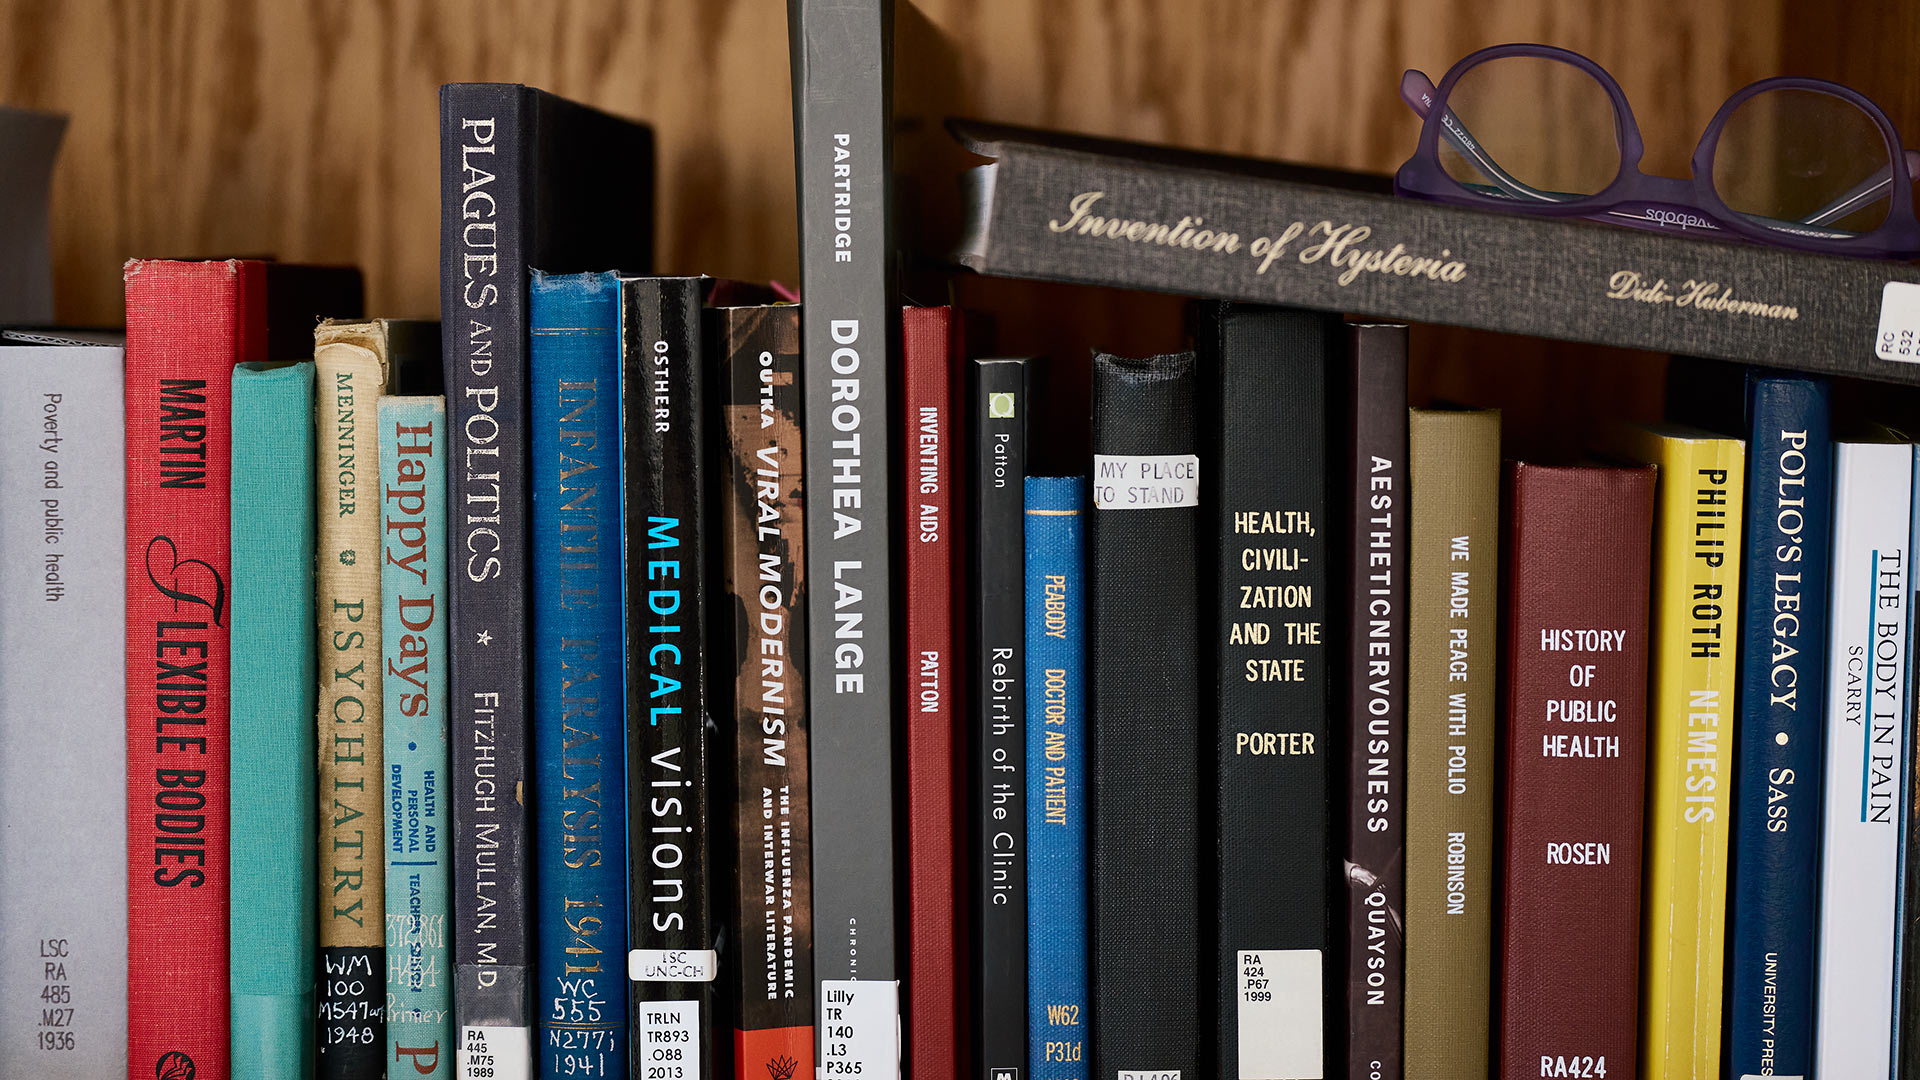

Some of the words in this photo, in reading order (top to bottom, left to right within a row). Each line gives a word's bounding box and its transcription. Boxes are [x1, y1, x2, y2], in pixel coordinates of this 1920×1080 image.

[462, 117, 498, 309] PLAGUES
[834, 133, 851, 262] PARTRIDGE
[1049, 191, 1240, 255] Invention
[1250, 222, 1304, 275] of
[1299, 220, 1468, 287] Hysteria
[1606, 270, 1799, 321] Didi-Huberman
[470, 319, 493, 376] AND
[1881, 332, 1895, 353] RC
[1899, 330, 1914, 356] 532
[654, 340, 670, 433] OSTHERR
[759, 351, 774, 429] OUTKA
[39, 393, 63, 453] Poverty
[160, 379, 206, 489] MARTIN
[336, 372, 356, 518] MENNINGER
[830, 319, 862, 540] DOROTHEA
[919, 406, 938, 494] INVENTING
[994, 433, 1010, 488] Patton
[1101, 462, 1127, 479] MY
[1141, 462, 1194, 480] PLACE
[44, 461, 63, 489] and
[465, 386, 500, 582] POLITICS
[559, 378, 600, 610] INFANTILE
[756, 446, 780, 542] VIRAL
[1096, 486, 1115, 502] TO
[1128, 486, 1184, 504] STAND
[40, 499, 64, 544] public
[386, 421, 433, 585] Happy
[920, 503, 938, 543] AIDS
[1234, 511, 1316, 537] HEALTH,
[1695, 469, 1727, 568] PHILIP
[1242, 548, 1309, 571] CIVILI-
[1451, 535, 1469, 562] WE
[45, 554, 65, 602] health
[1240, 585, 1312, 609] ZATION
[1450, 572, 1469, 619] MADE
[1878, 549, 1901, 610] THE
[647, 516, 682, 725] MEDICAL
[834, 560, 864, 694] LANGE
[1045, 574, 1066, 639] PEABODY
[1690, 584, 1723, 658] ROTH
[388, 594, 435, 718] Days
[1229, 623, 1270, 646] AND
[1284, 622, 1321, 646] THE
[1367, 455, 1392, 833] AESTHETICNERVOUSNESS
[1449, 629, 1468, 683] PEACE
[1541, 629, 1626, 651] HISTORY
[1770, 572, 1802, 711] LEGACY
[759, 553, 786, 767] MODERNISM
[920, 651, 939, 713] PATTON
[1245, 659, 1305, 682] STATE
[1569, 665, 1596, 687] OF
[1875, 622, 1899, 701] BODY
[992, 647, 1015, 736] Rebirth
[1044, 669, 1066, 725] DOCTOR
[1846, 645, 1864, 725] SCARRY
[1448, 692, 1466, 736] WITH
[1546, 699, 1617, 723] PUBLIC
[1874, 712, 1896, 746] IN
[333, 599, 366, 928] PSYCHIATRY
[473, 692, 499, 813] FITZHUGH
[561, 636, 602, 869] PARALYSIS
[992, 748, 1015, 772] of
[1045, 730, 1066, 762] AND
[1236, 732, 1315, 755] PORTER
[1543, 735, 1619, 758] HEALTH
[1684, 689, 1719, 823] NEMESIS
[1448, 745, 1466, 795] POLIO
[1870, 755, 1893, 825] PAIN
[391, 763, 403, 854] DEVELOPMENT
[424, 770, 436, 817] HEALTH
[762, 788, 772, 819] AND
[780, 786, 789, 815] THE
[992, 784, 1015, 820] the
[1045, 767, 1066, 826] PATIENT
[1767, 767, 1795, 833] SASS
[154, 769, 206, 888] BODIES
[408, 789, 419, 853] PERSONAL
[424, 824, 436, 853] AND
[651, 746, 692, 932] visions
[764, 824, 774, 906] INTERWAR
[781, 820, 792, 911] INFLUENZA
[992, 832, 1015, 905] Clinic
[1447, 832, 1465, 915] ROBINSON
[1547, 842, 1610, 865] ROSEN
[475, 823, 500, 934] MULLAN,
[40, 940, 69, 958] LSC
[564, 895, 603, 978] 1941
[765, 911, 777, 1000] LITERATURE
[783, 916, 794, 999] PANDEMIC
[1364, 892, 1386, 1005] QUAYSON
[45, 962, 67, 981] RA
[326, 954, 372, 976] WM
[476, 941, 498, 990] M.D.
[645, 965, 704, 978] UNC-CH
[1244, 955, 1261, 965] RA
[1244, 967, 1264, 977] 424
[41, 986, 70, 1004] 485
[328, 980, 364, 997] 100
[557, 977, 598, 998] WC
[826, 990, 855, 1005] Lilly
[1244, 980, 1269, 989] .P67
[1244, 992, 1272, 1002] 1999
[1762, 952, 1778, 1036] UNIVERSITY
[37, 1008, 74, 1027] .M27
[552, 997, 606, 1022] 555
[647, 1013, 680, 1024] TRLN
[826, 1008, 842, 1020] TR
[827, 1026, 853, 1038] 140
[1047, 1004, 1079, 1026] W62
[37, 1032, 75, 1051] 1936
[328, 1026, 374, 1044] 1948
[396, 1040, 439, 1075] P
[467, 1031, 485, 1041] RA
[467, 1043, 487, 1053] 445
[647, 1030, 689, 1043] TR893
[826, 1044, 847, 1056] .L3
[1046, 1041, 1082, 1062] P31d
[467, 1056, 494, 1065] .M75
[467, 1068, 494, 1077] 1989
[555, 1052, 604, 1077] 1941
[648, 1067, 683, 1079] 2013
[826, 1061, 862, 1074] P365
[1540, 1056, 1607, 1079] RA424
